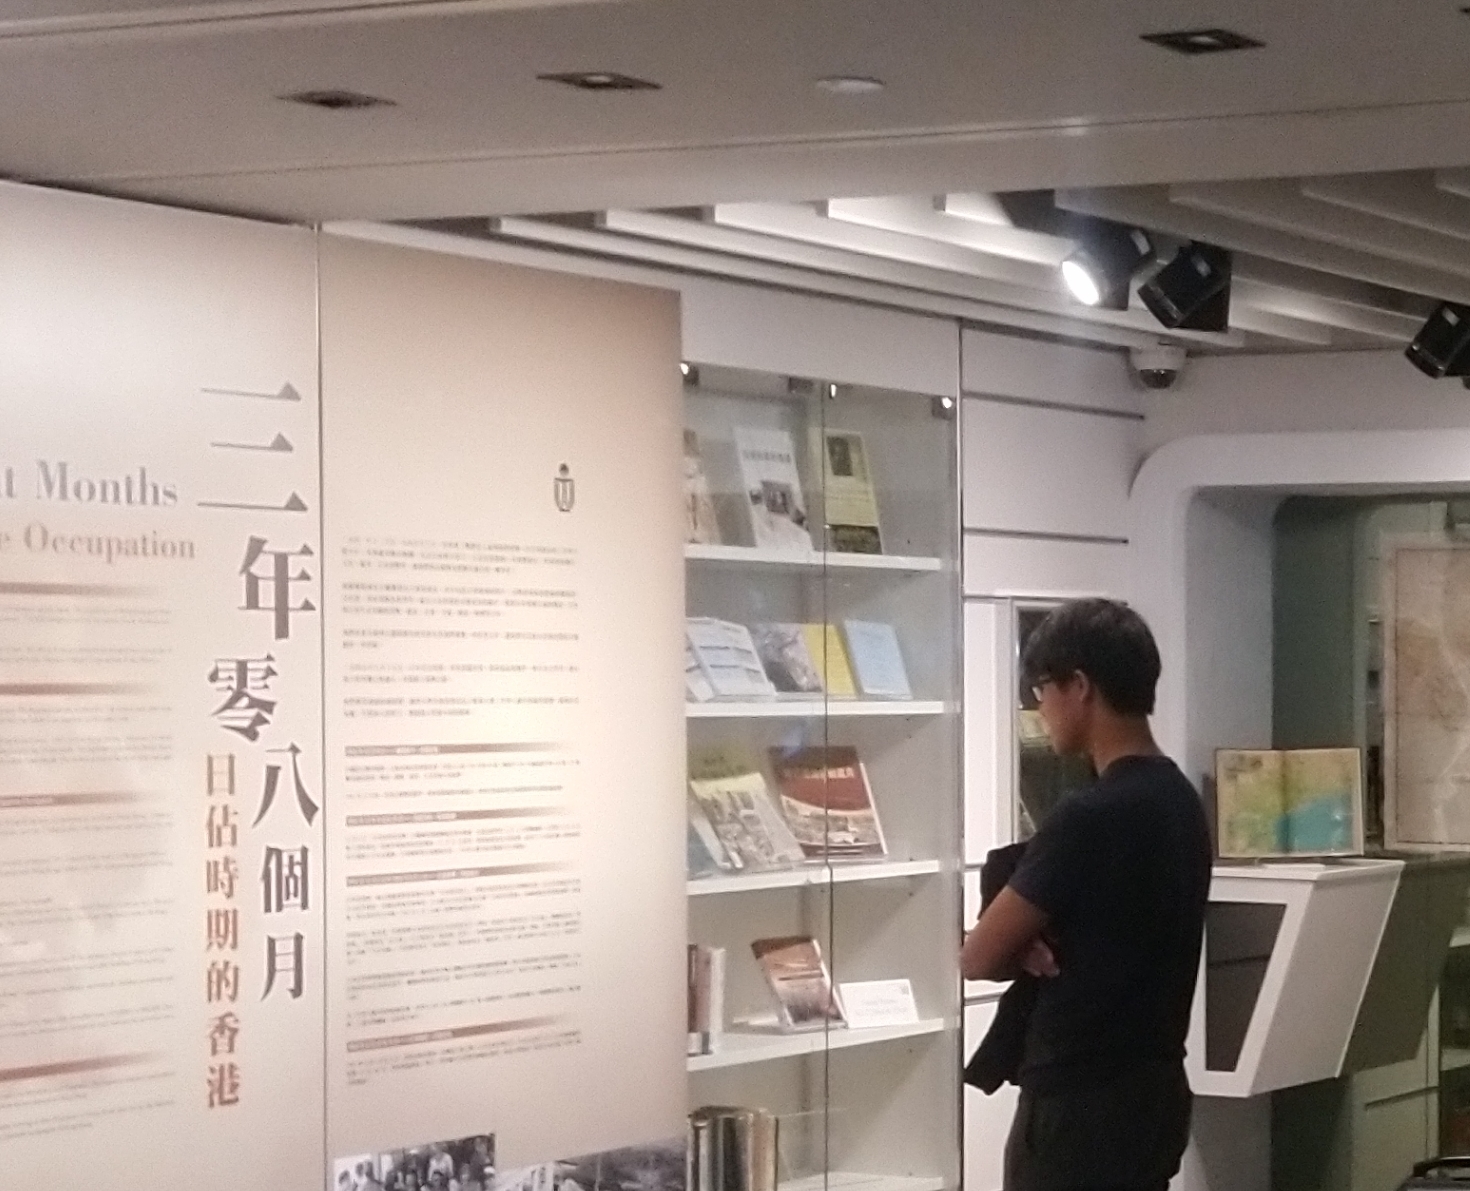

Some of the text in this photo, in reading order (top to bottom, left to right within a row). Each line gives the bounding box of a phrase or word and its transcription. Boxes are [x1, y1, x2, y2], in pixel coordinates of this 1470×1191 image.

[23, 522, 196, 564] Occupation
[36, 459, 178, 507] Months
[197, 381, 319, 1001] 三年零八個月
[205, 752, 241, 1109] 日佔時期的香港
